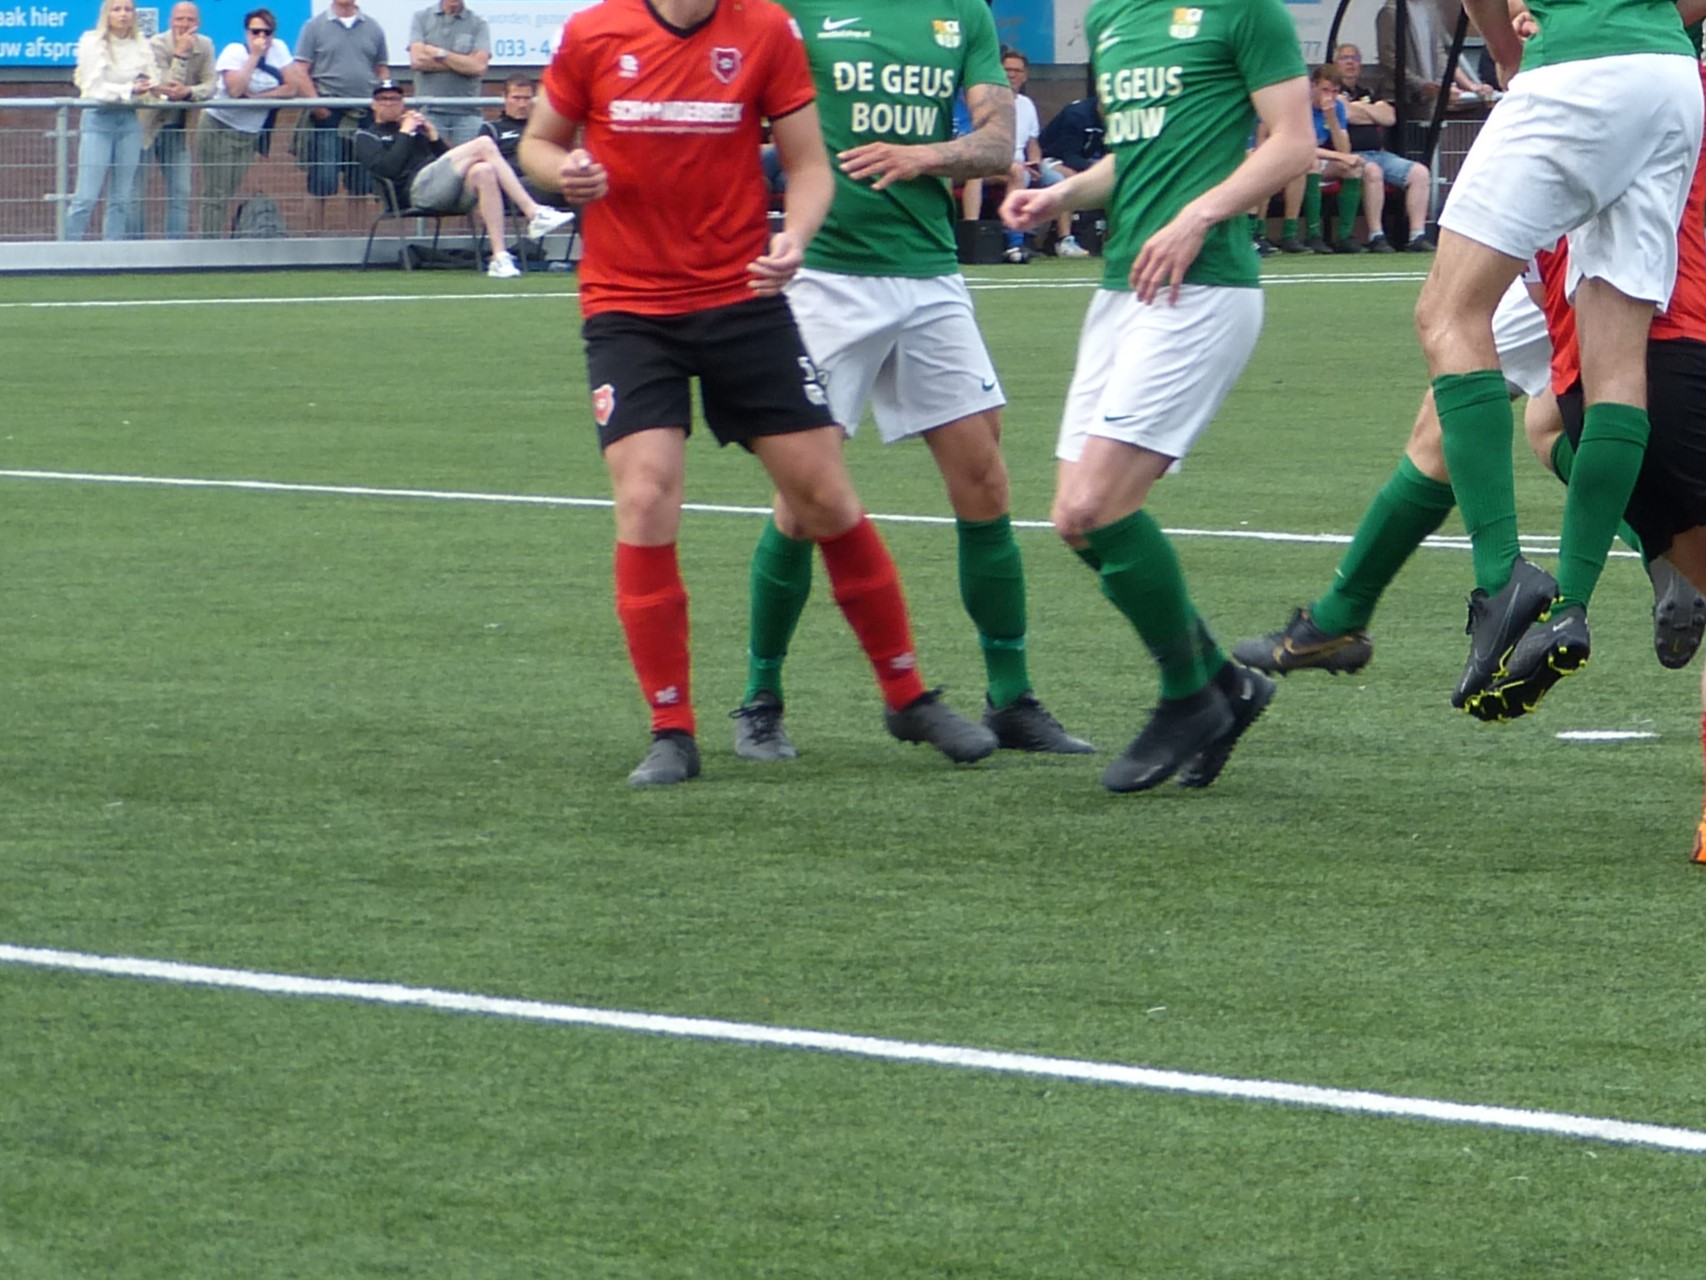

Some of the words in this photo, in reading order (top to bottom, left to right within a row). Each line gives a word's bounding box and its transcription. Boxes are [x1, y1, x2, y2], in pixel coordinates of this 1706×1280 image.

[30, 6, 69, 27] hier
[25, 35, 80, 62] afspra
[495, 39, 526, 57] 033
[832, 61, 875, 92] DE
[881, 64, 956, 98] GEUS
[1114, 65, 1184, 100] GEUS
[851, 101, 939, 136] BOUW
[1103, 106, 1167, 145] OUW
